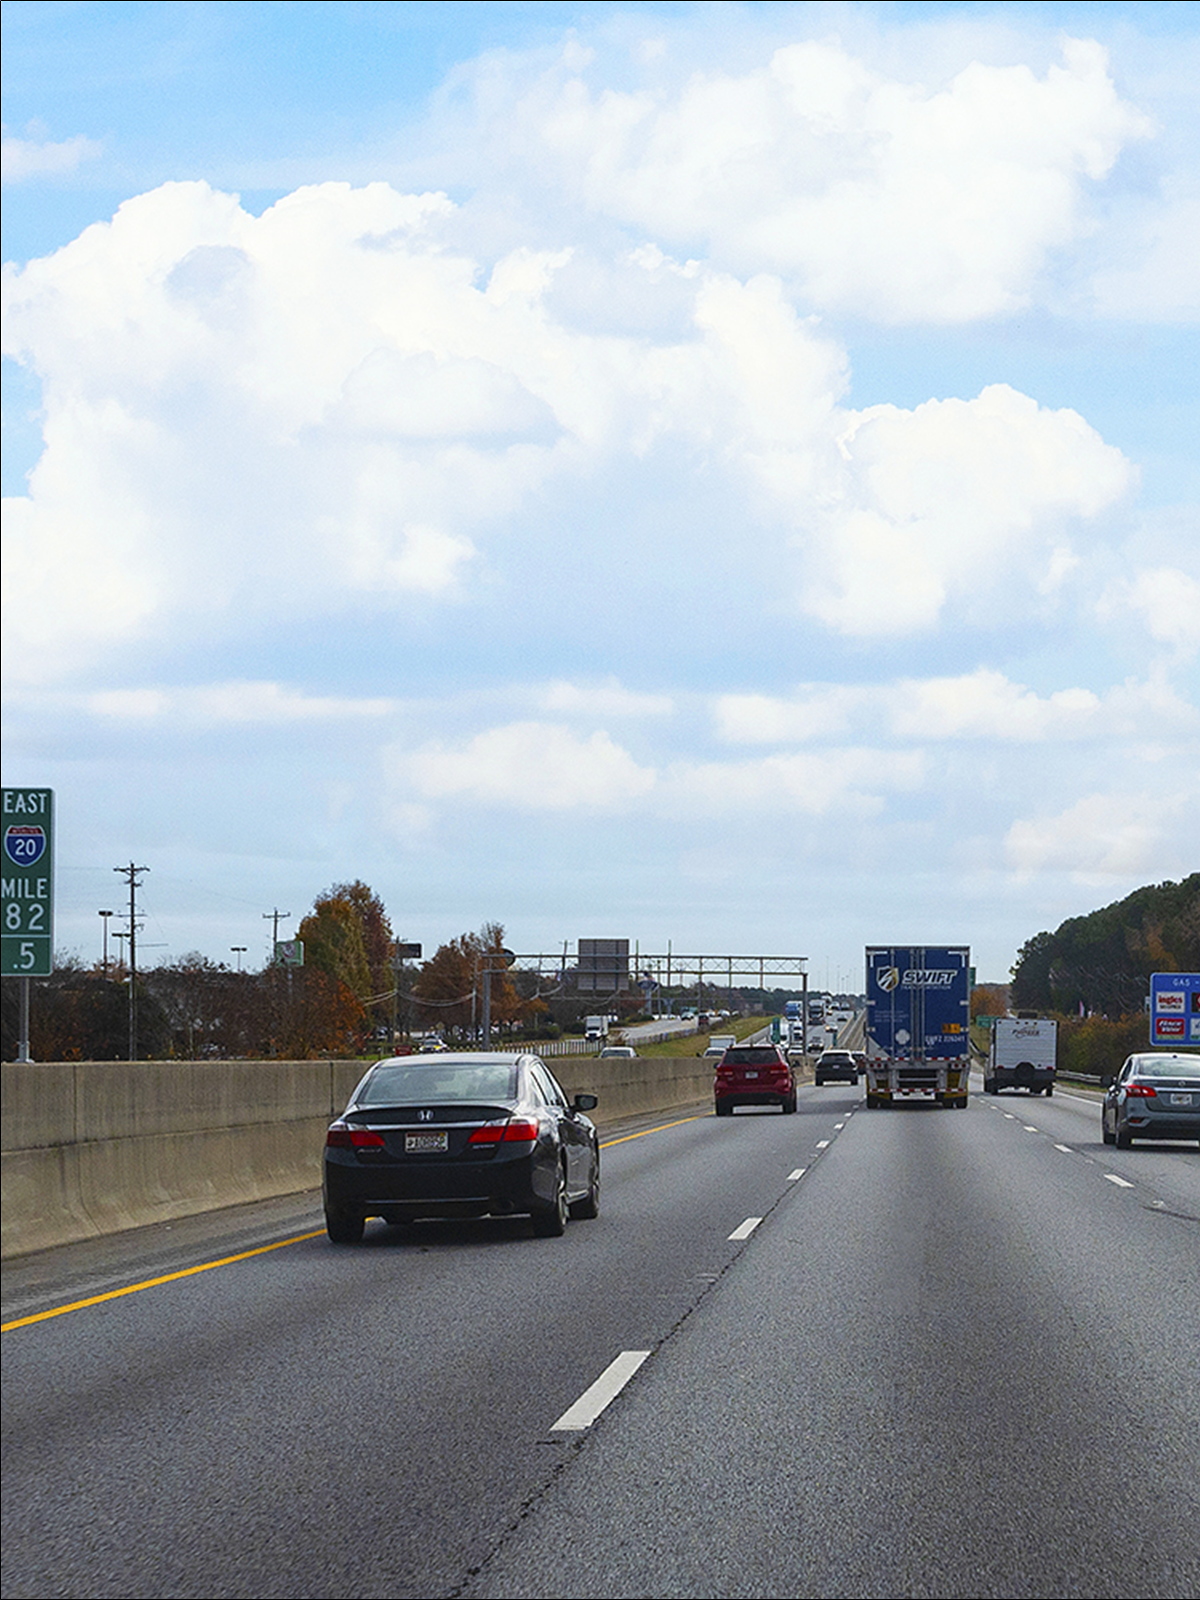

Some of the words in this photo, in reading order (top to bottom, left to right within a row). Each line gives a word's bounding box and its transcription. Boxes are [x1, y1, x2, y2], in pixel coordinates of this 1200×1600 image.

[3, 791, 47, 814] EAST
[15, 839, 36, 856] 20
[1, 878, 48, 899] MILE
[6, 903, 44, 930] 82
[13, 942, 35, 969] .5
[902, 969, 958, 985] SWIFT
[1172, 978, 1190, 987] GAS
